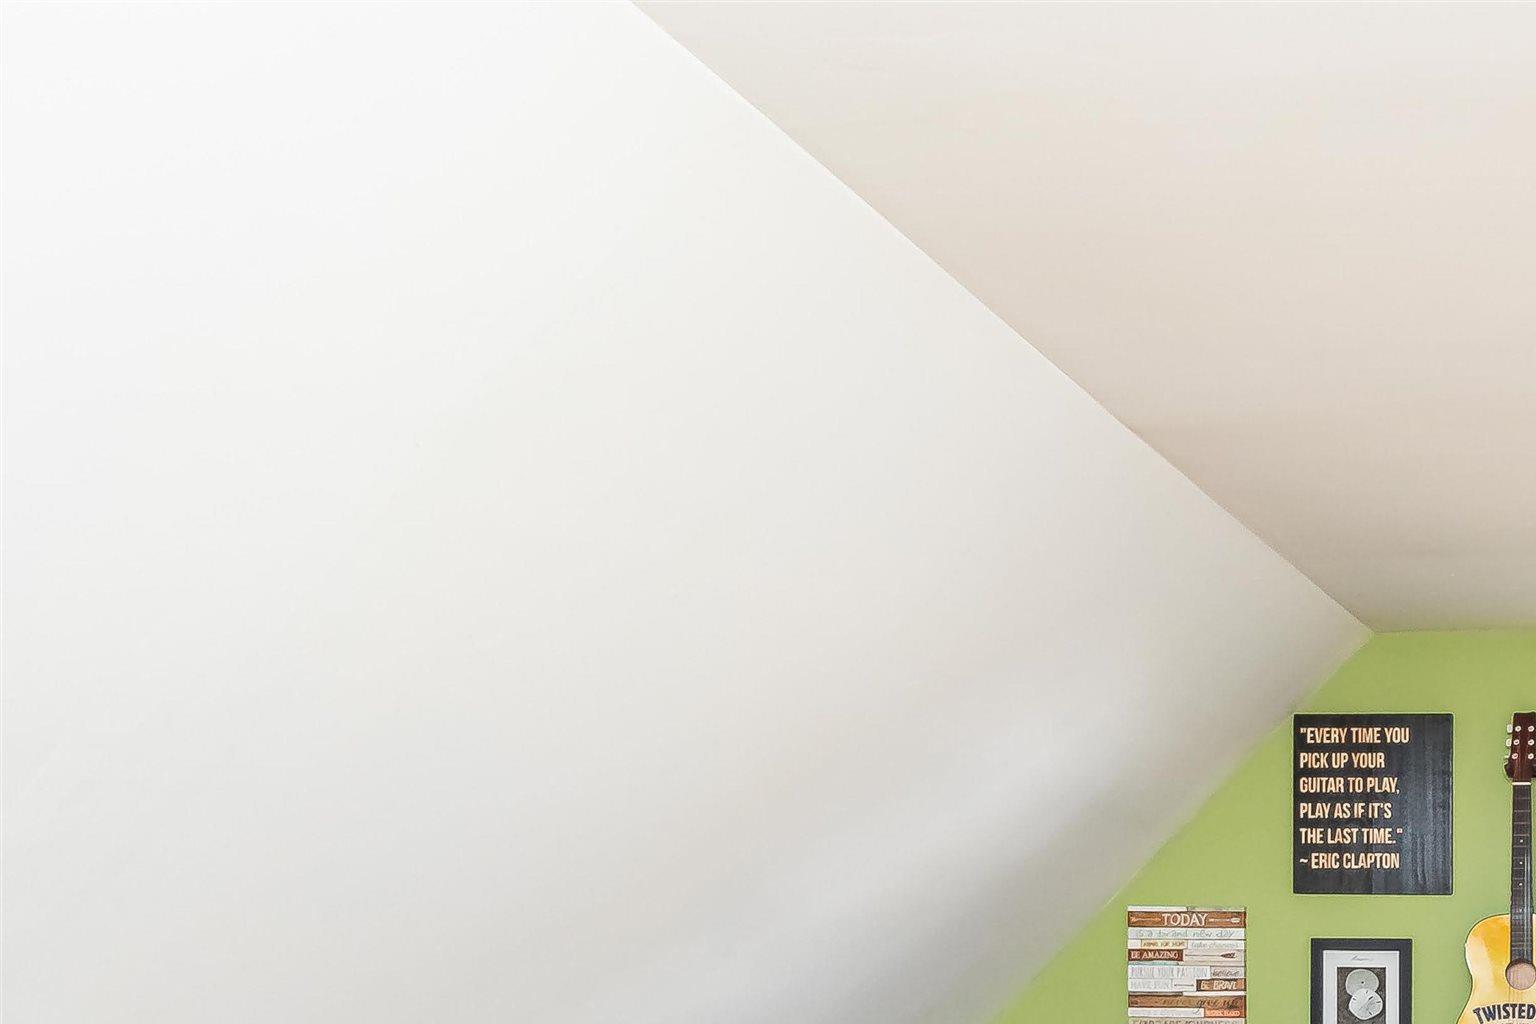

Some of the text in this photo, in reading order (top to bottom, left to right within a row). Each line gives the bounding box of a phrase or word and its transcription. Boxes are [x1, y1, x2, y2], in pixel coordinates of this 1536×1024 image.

[1300, 727, 1410, 744] "EVERY TIME YOU
[1300, 752, 1385, 769] PICK UP YOUR
[1300, 777, 1400, 795] GUITAR TO PLAY,
[1300, 802, 1392, 819] PLAY AS IF IT'S
[1299, 828, 1324, 844] THE
[1327, 828, 1359, 844] LAST
[1311, 852, 1340, 869] ERIC
[1343, 852, 1400, 869] CLAPTON
[1162, 913, 1208, 926] TODAY
[1130, 951, 1179, 959] BE AMAZING
[1472, 1003, 1536, 1024] TWISTED
